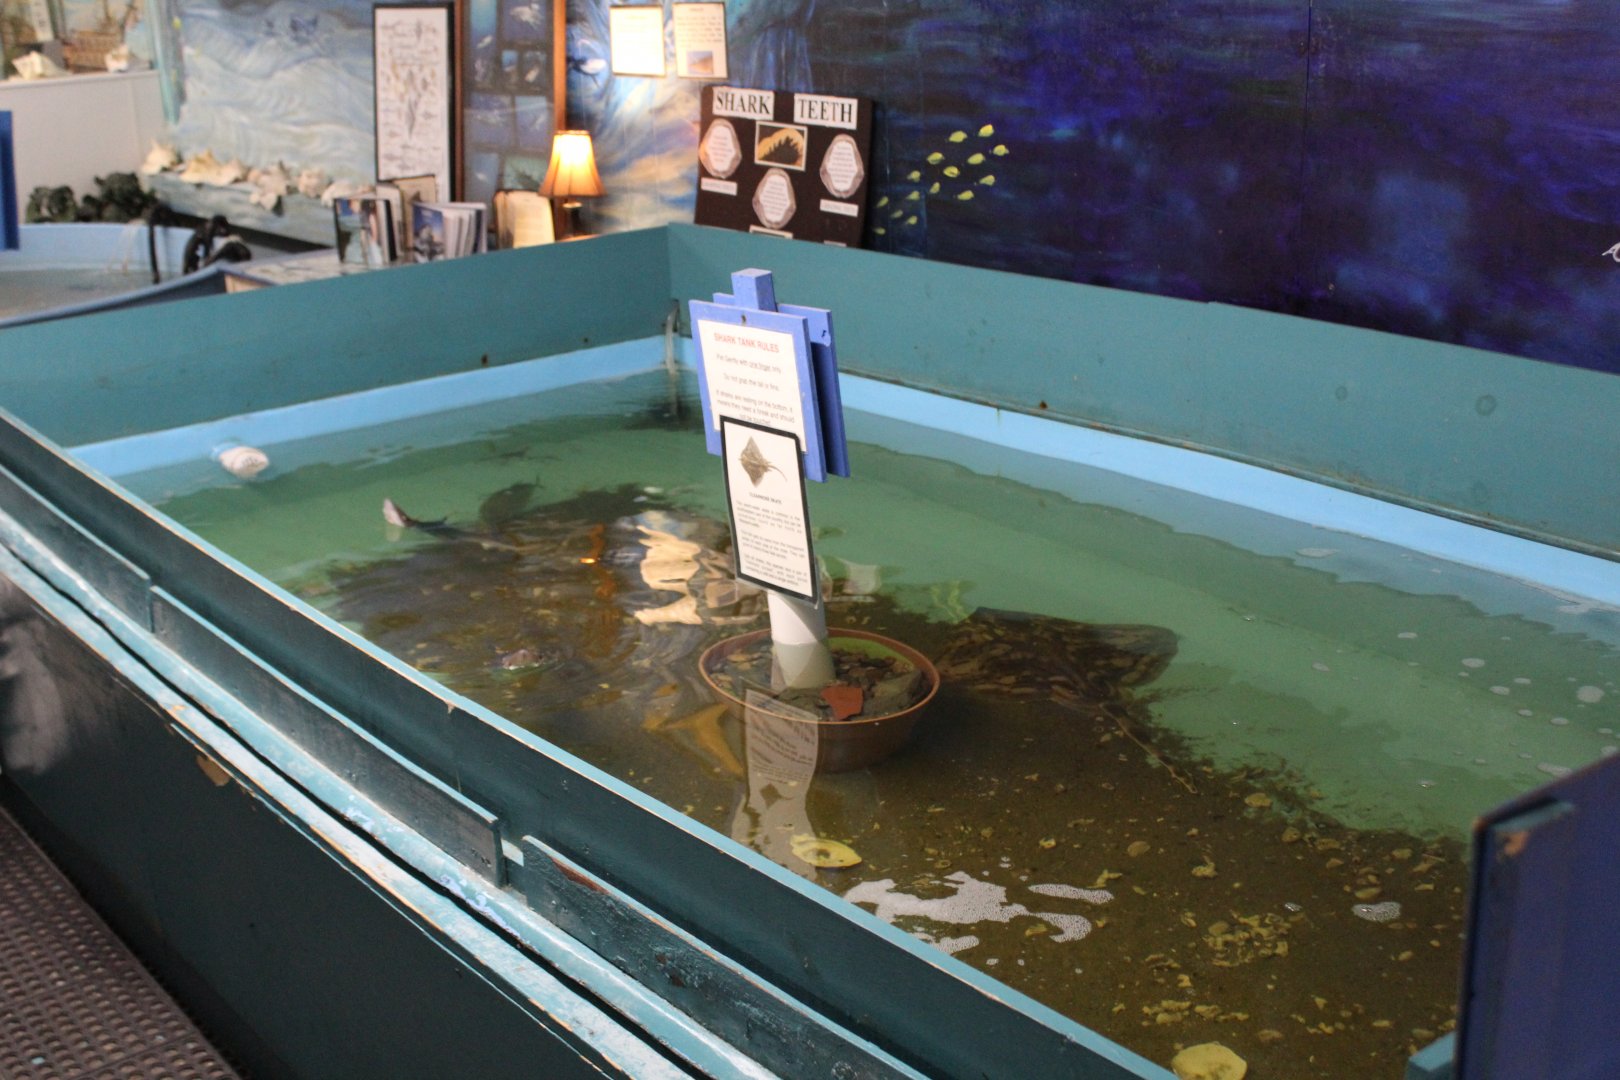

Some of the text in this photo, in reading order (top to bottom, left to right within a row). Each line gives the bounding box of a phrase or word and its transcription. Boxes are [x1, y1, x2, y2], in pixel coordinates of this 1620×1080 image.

[716, 91, 853, 123] SHARK TEETH
[713, 333, 780, 353] SHARK TANK RULES
